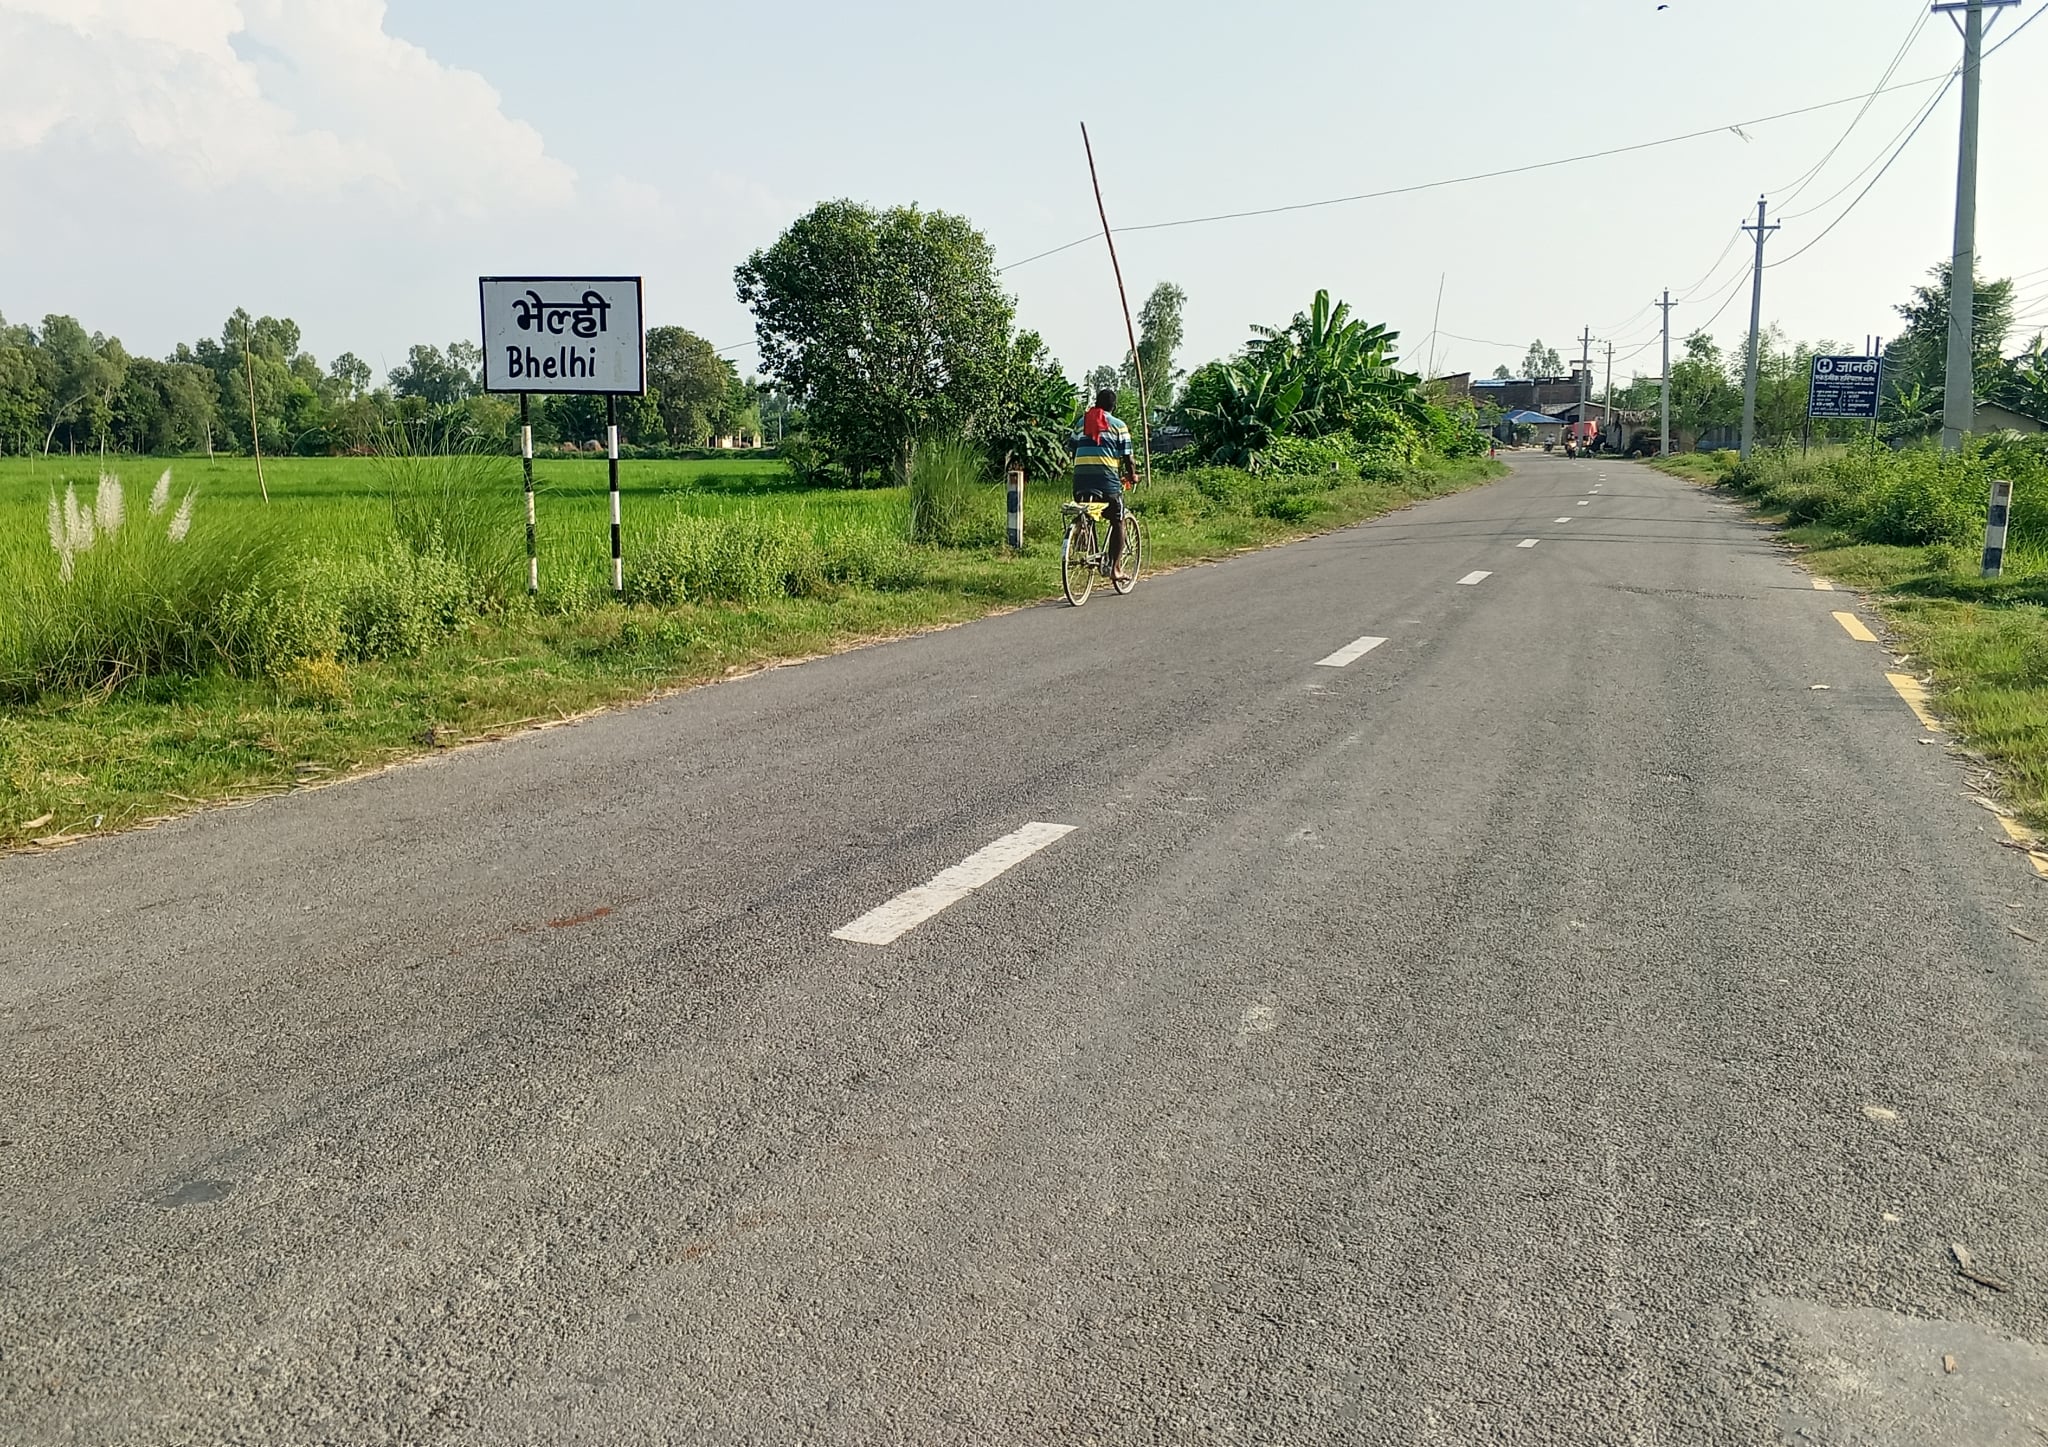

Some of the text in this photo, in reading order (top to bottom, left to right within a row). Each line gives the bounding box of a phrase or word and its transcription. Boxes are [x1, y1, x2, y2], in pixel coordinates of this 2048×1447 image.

[512, 290, 611, 338] भेल्ही
[506, 345, 596, 378] Bhelhi
[1836, 359, 1879, 373] जानकी
